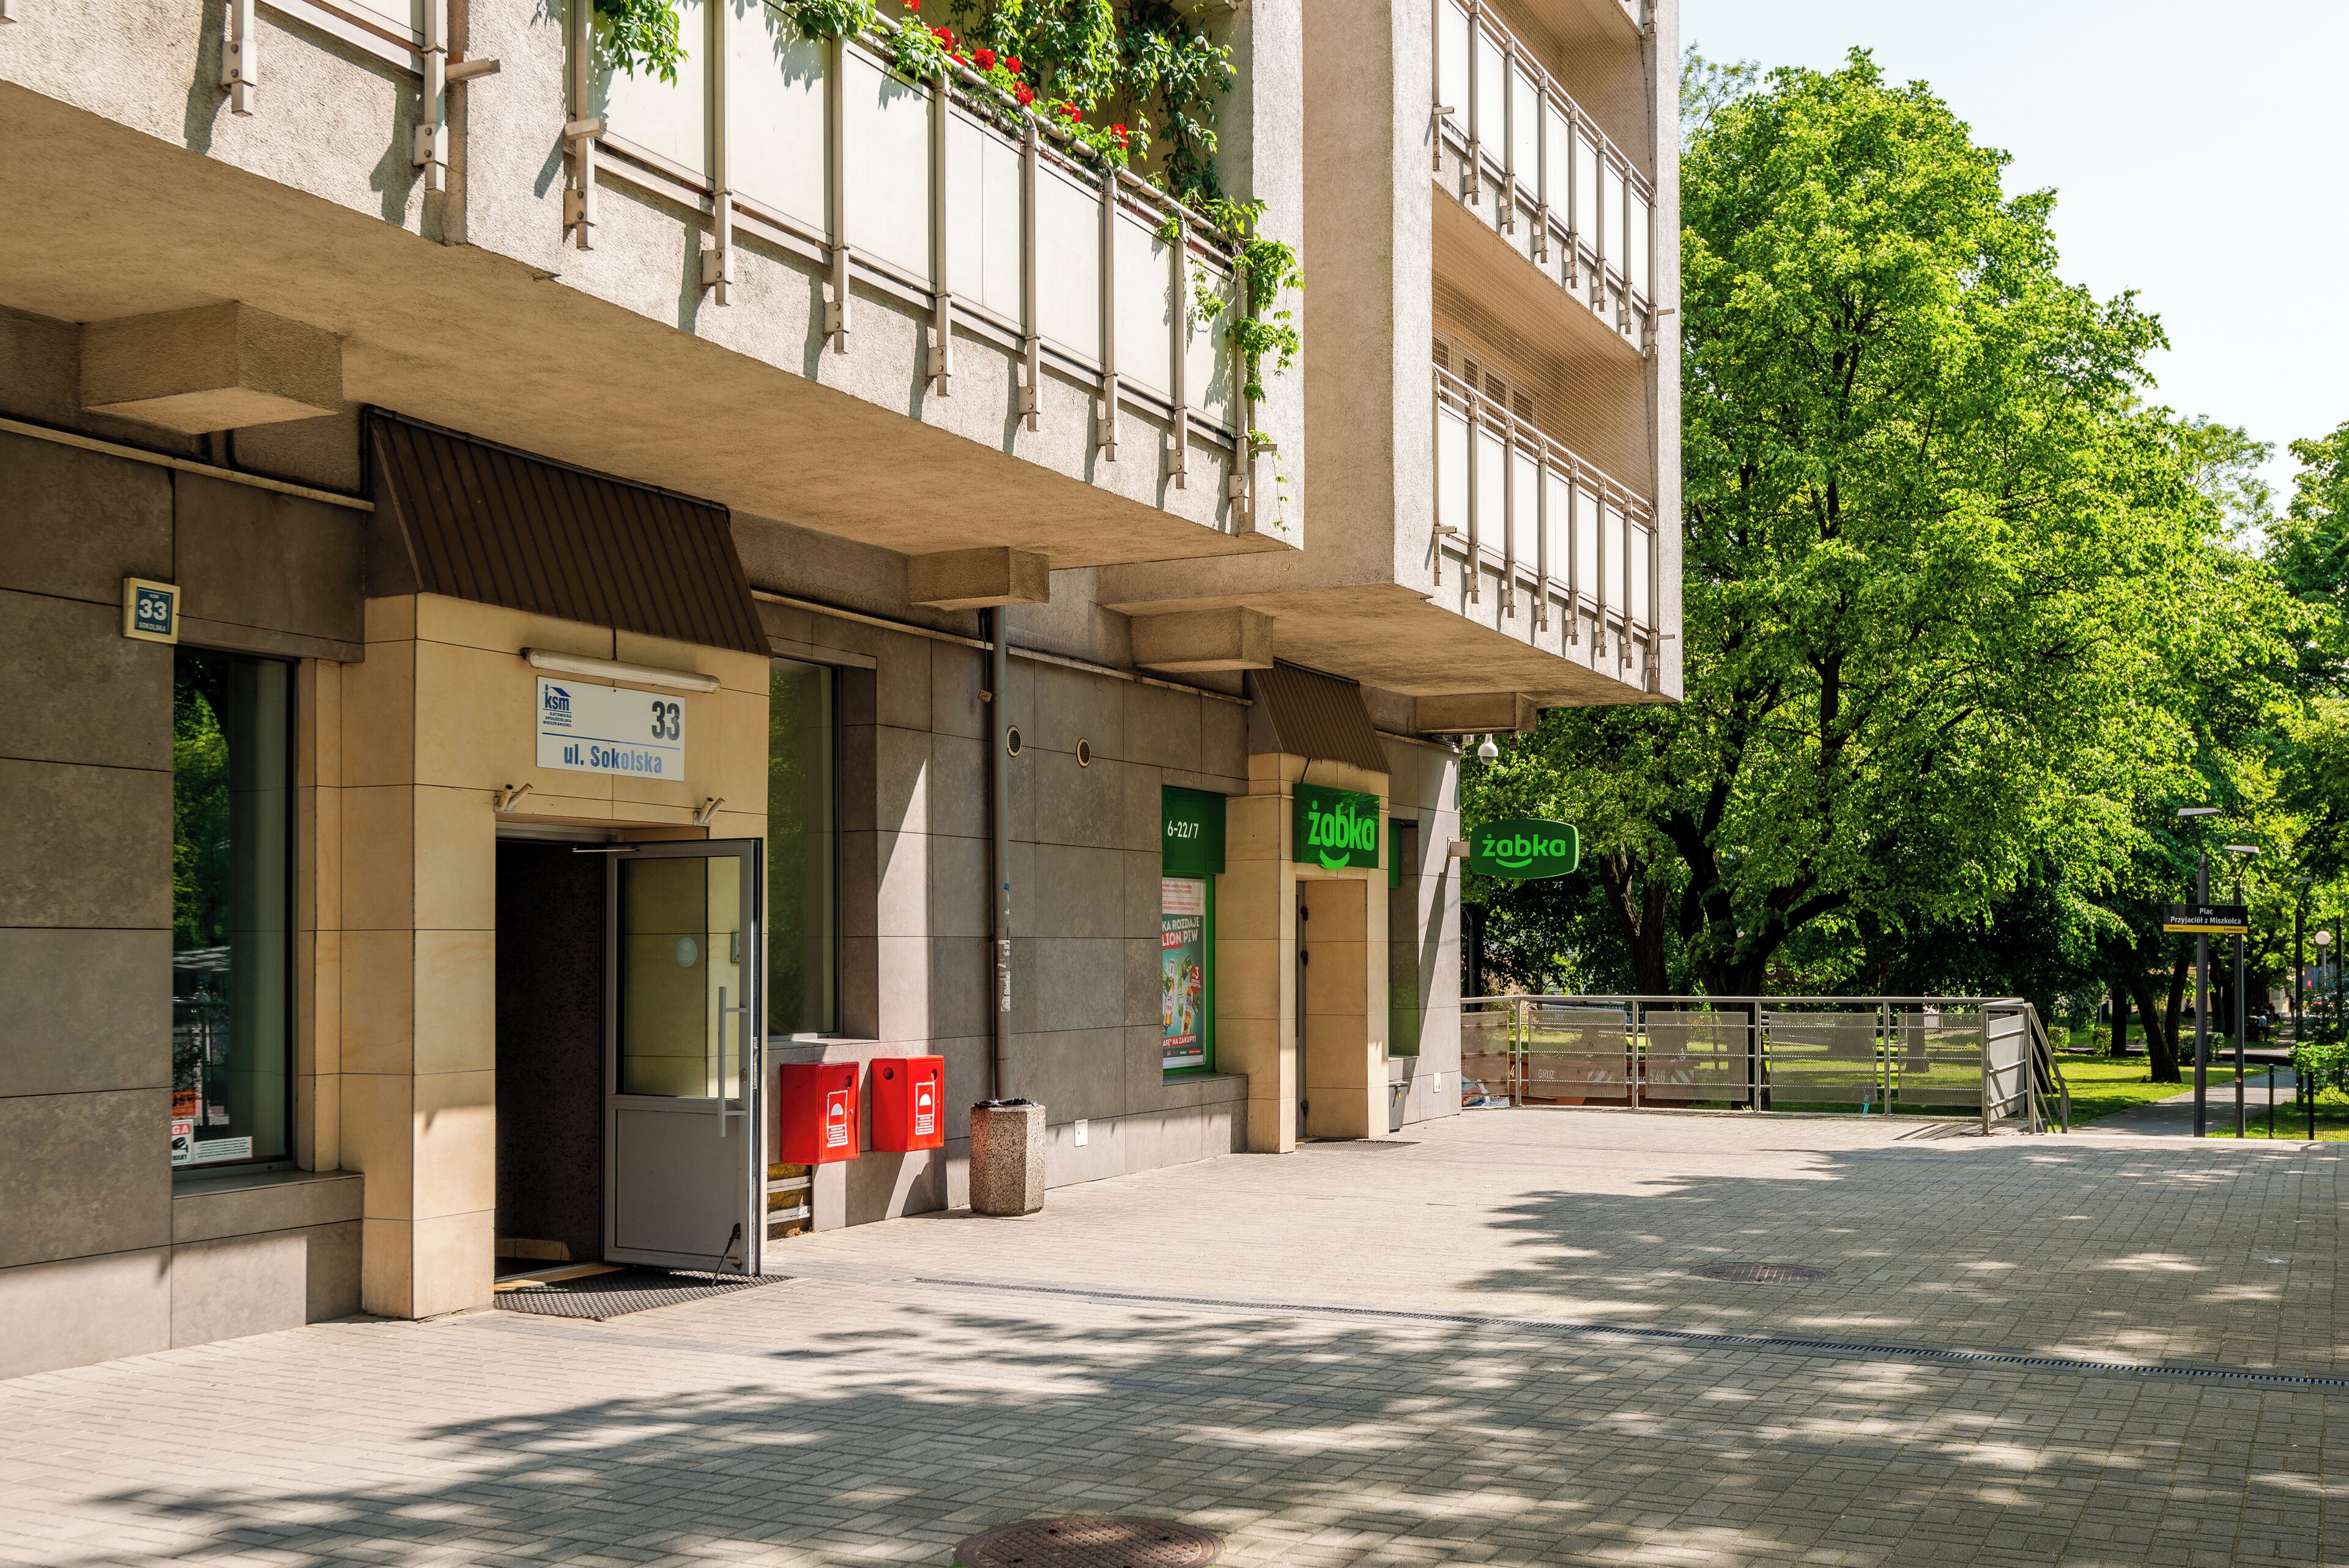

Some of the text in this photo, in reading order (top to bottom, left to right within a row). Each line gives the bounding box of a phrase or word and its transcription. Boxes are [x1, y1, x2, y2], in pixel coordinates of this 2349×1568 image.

[139, 598, 167, 620] 33
[138, 622, 166, 632] SOKOLSKA
[545, 684, 570, 711] ksm
[651, 700, 680, 741] 33
[564, 744, 662, 774] ul. Sokolska
[1167, 820, 1199, 839] 6-22/7
[1307, 800, 1375, 852] żabka
[1482, 833, 1566, 857] żabka
[1172, 917, 1200, 930] ROZDAJE
[2170, 916, 2203, 924] Przyjaciół
[1183, 929, 1198, 943] PIW
[1538, 1068, 1555, 1080] GRUZ
